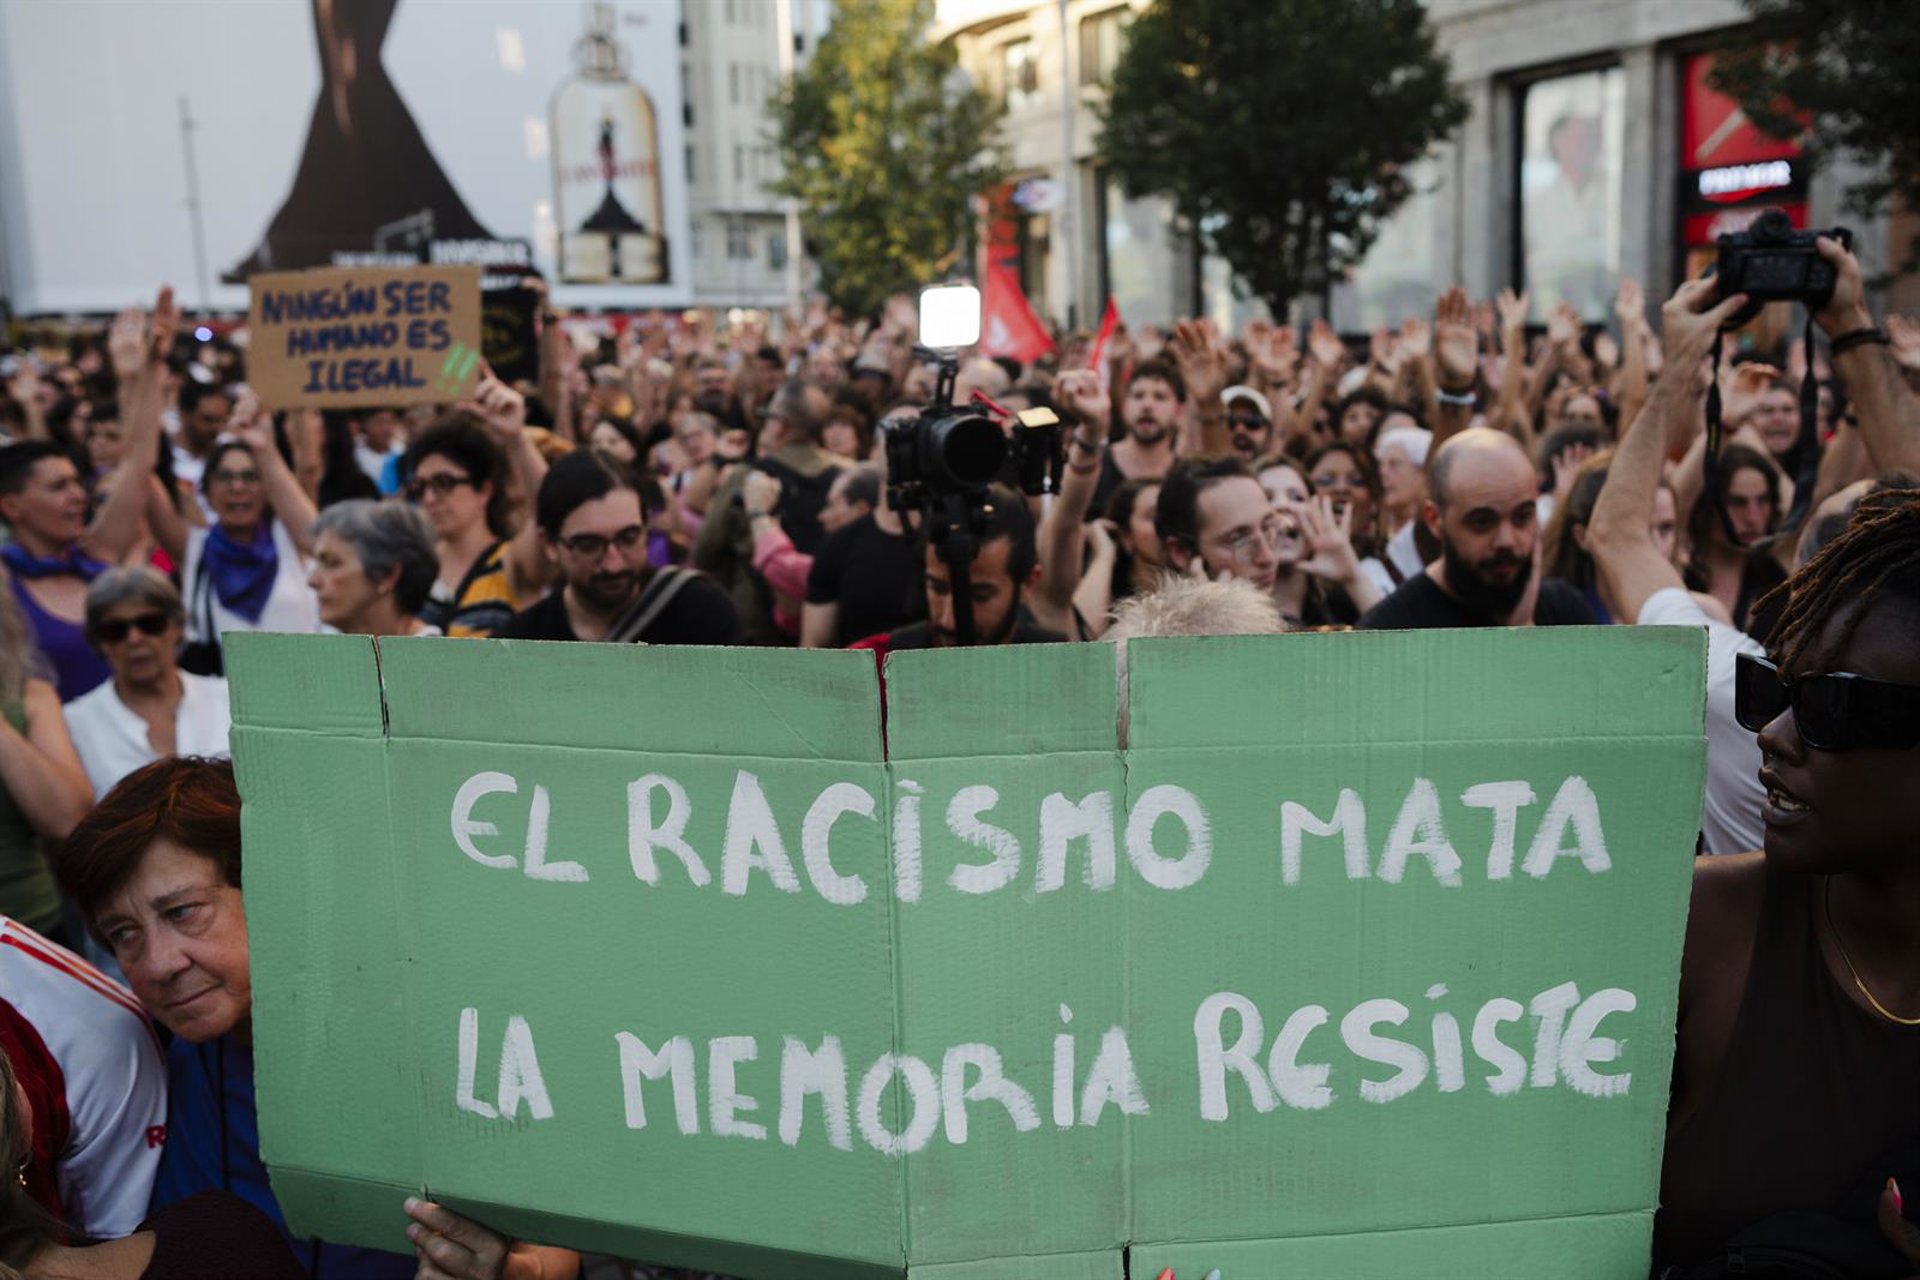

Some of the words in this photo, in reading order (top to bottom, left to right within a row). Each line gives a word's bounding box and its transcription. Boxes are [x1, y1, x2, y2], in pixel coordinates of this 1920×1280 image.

[384, 280, 451, 316] SER
[407, 319, 452, 351] ES
[450, 771, 590, 883] EL
[1280, 776, 1612, 887] MATA
[456, 1007, 554, 1120] LA
